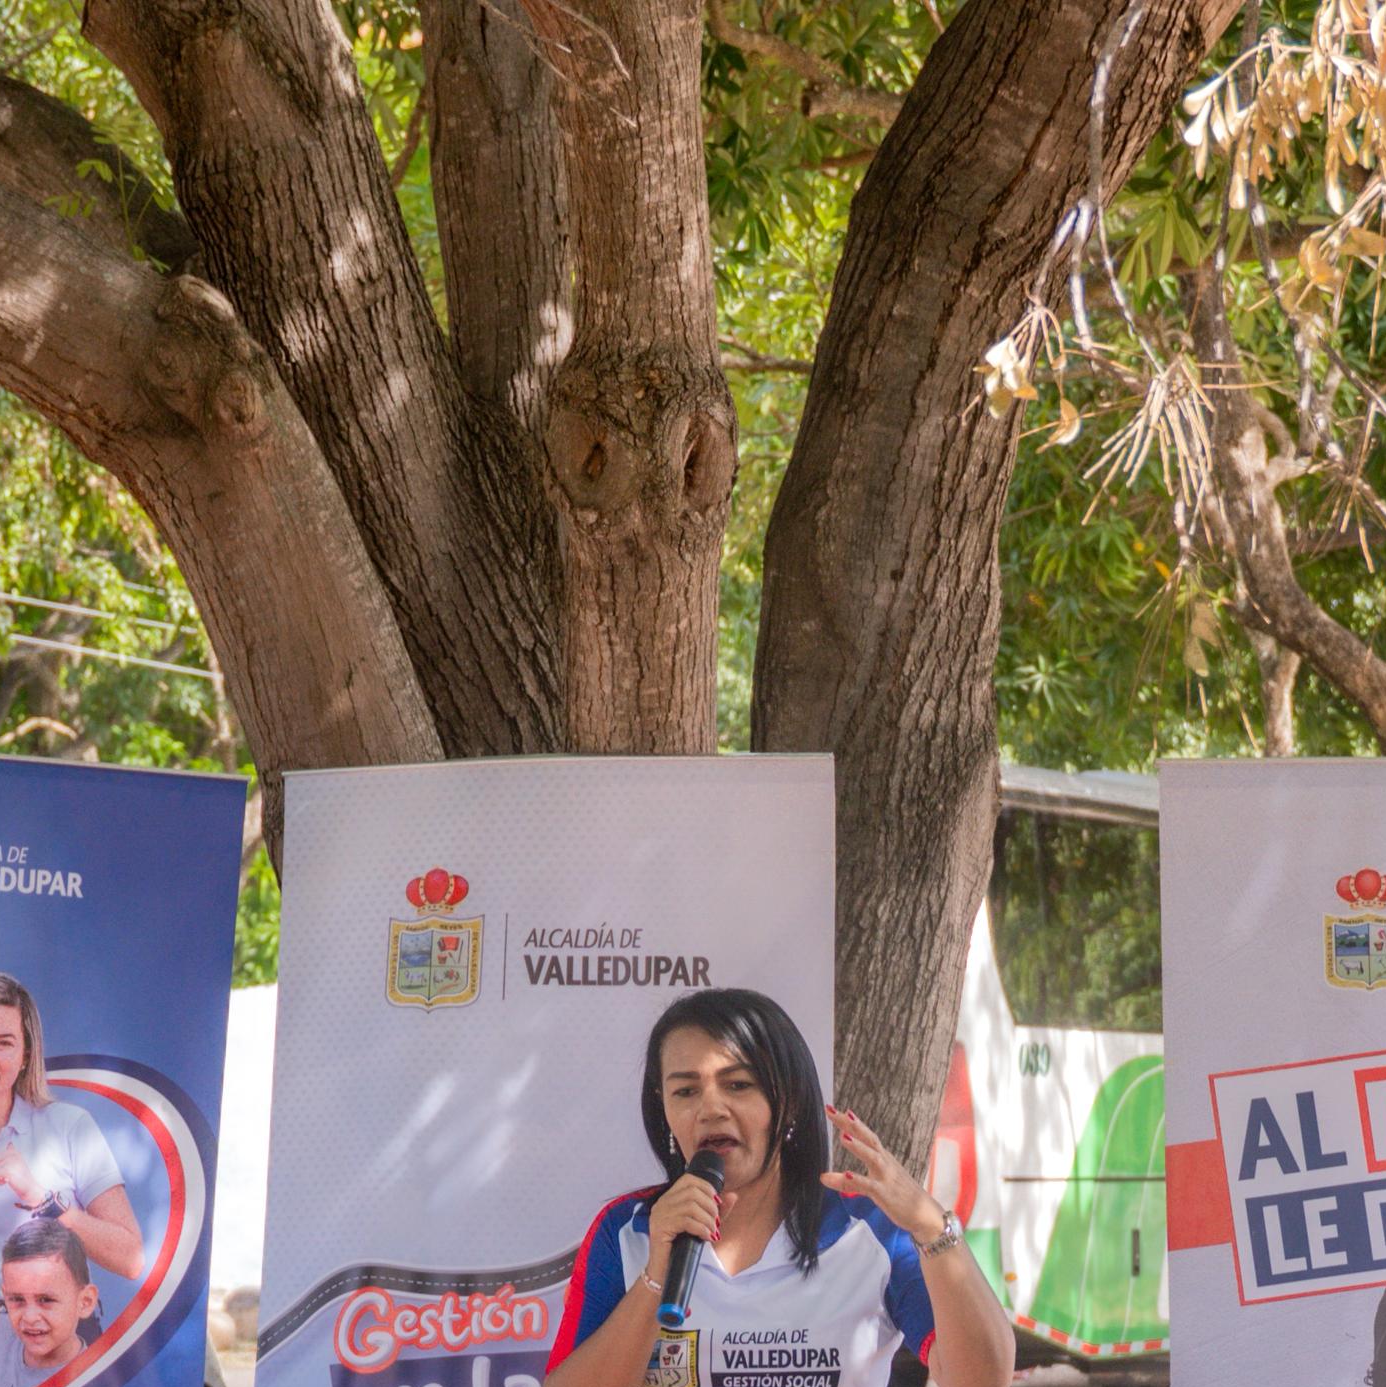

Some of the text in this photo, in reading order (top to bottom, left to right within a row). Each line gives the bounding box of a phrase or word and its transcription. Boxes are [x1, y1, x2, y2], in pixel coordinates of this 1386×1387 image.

[8, 845, 29, 864] DE
[524, 922, 643, 949] ALCALDÍA DE
[524, 954, 711, 988] VALLEDUPAR
[1238, 1091, 1348, 1182] AL
[1262, 1195, 1348, 1277] LE
[336, 1284, 545, 1367] Gestión
[722, 1328, 809, 1345] ALCALDÍA DE
[722, 1347, 841, 1370] VALLEDUPAR
